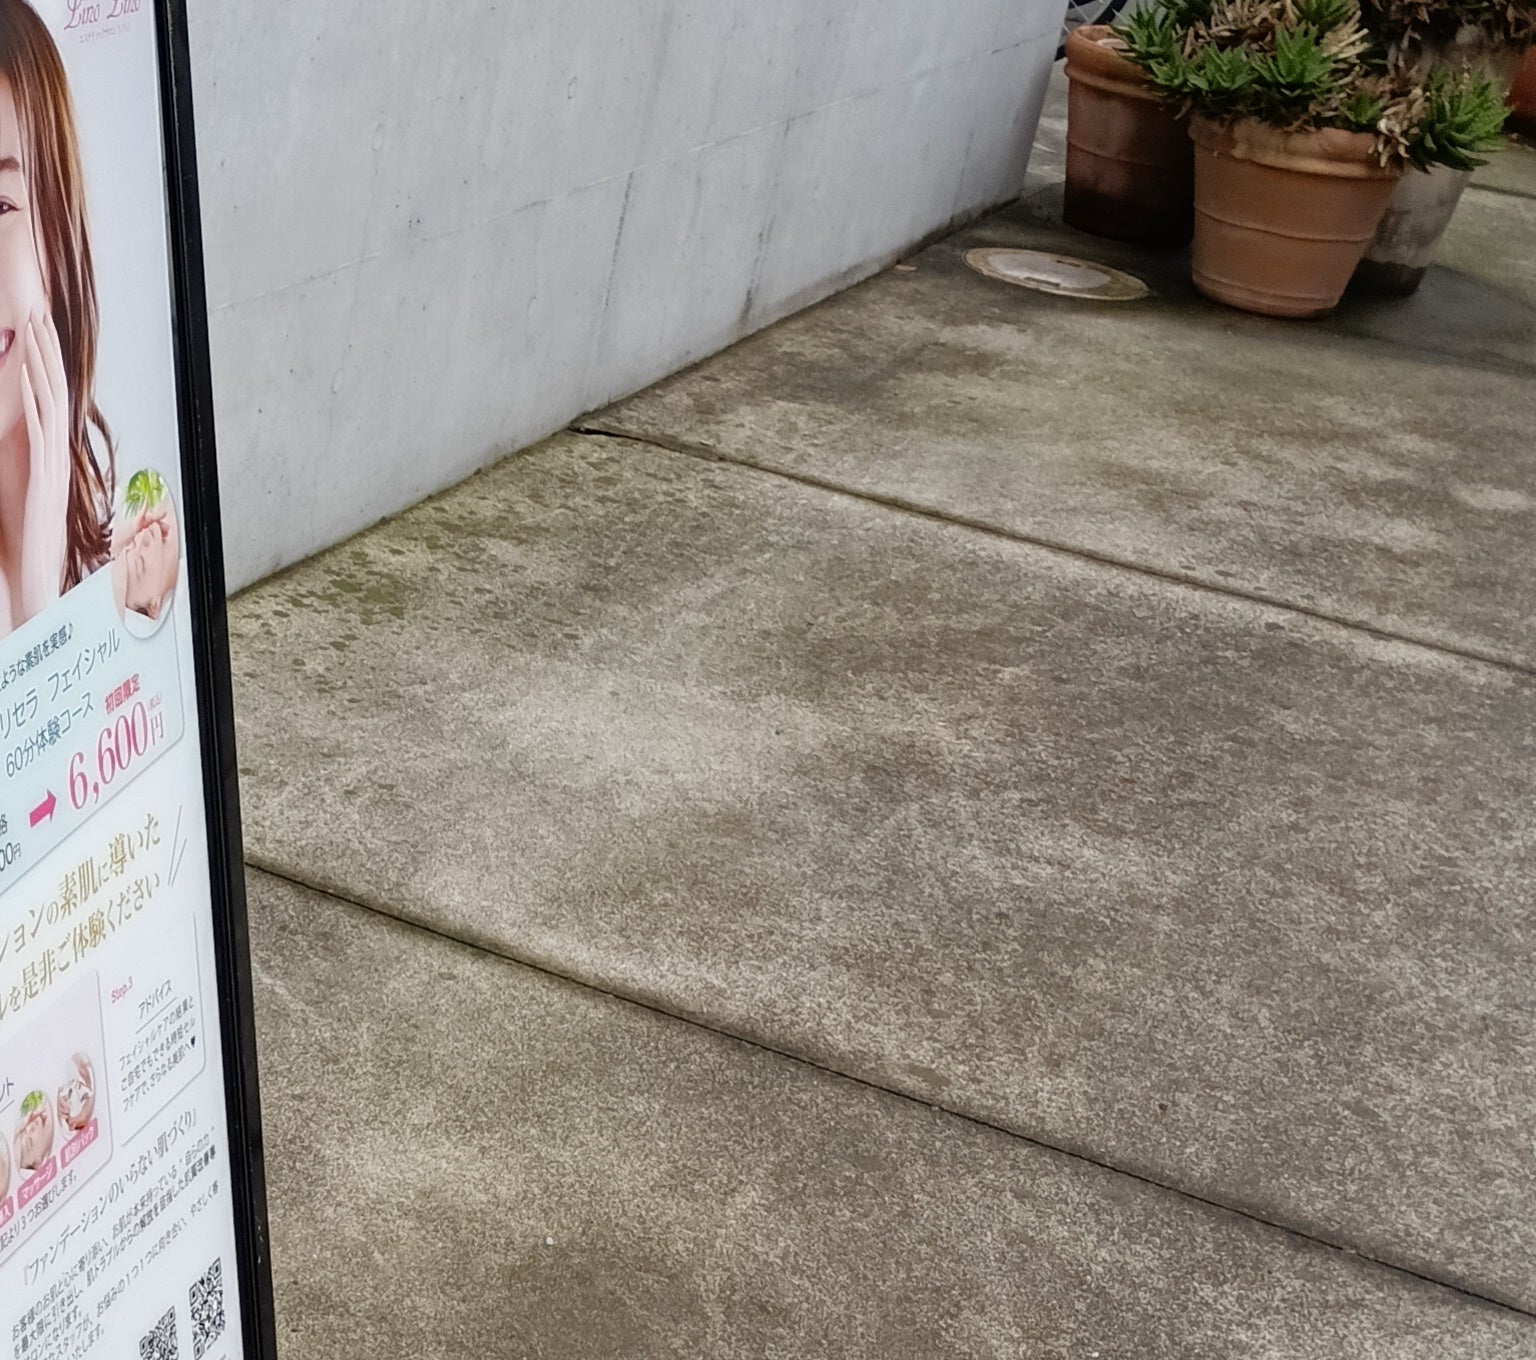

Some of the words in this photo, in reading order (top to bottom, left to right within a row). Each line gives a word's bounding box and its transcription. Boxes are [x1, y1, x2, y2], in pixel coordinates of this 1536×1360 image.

[47, 626, 120, 701] フェイシャル
[105, 675, 141, 713] 初回限定
[5, 691, 94, 778] 60分体験コース
[110, 976, 133, 1004] Step.3
[138, 978, 172, 1017] アドバイス
